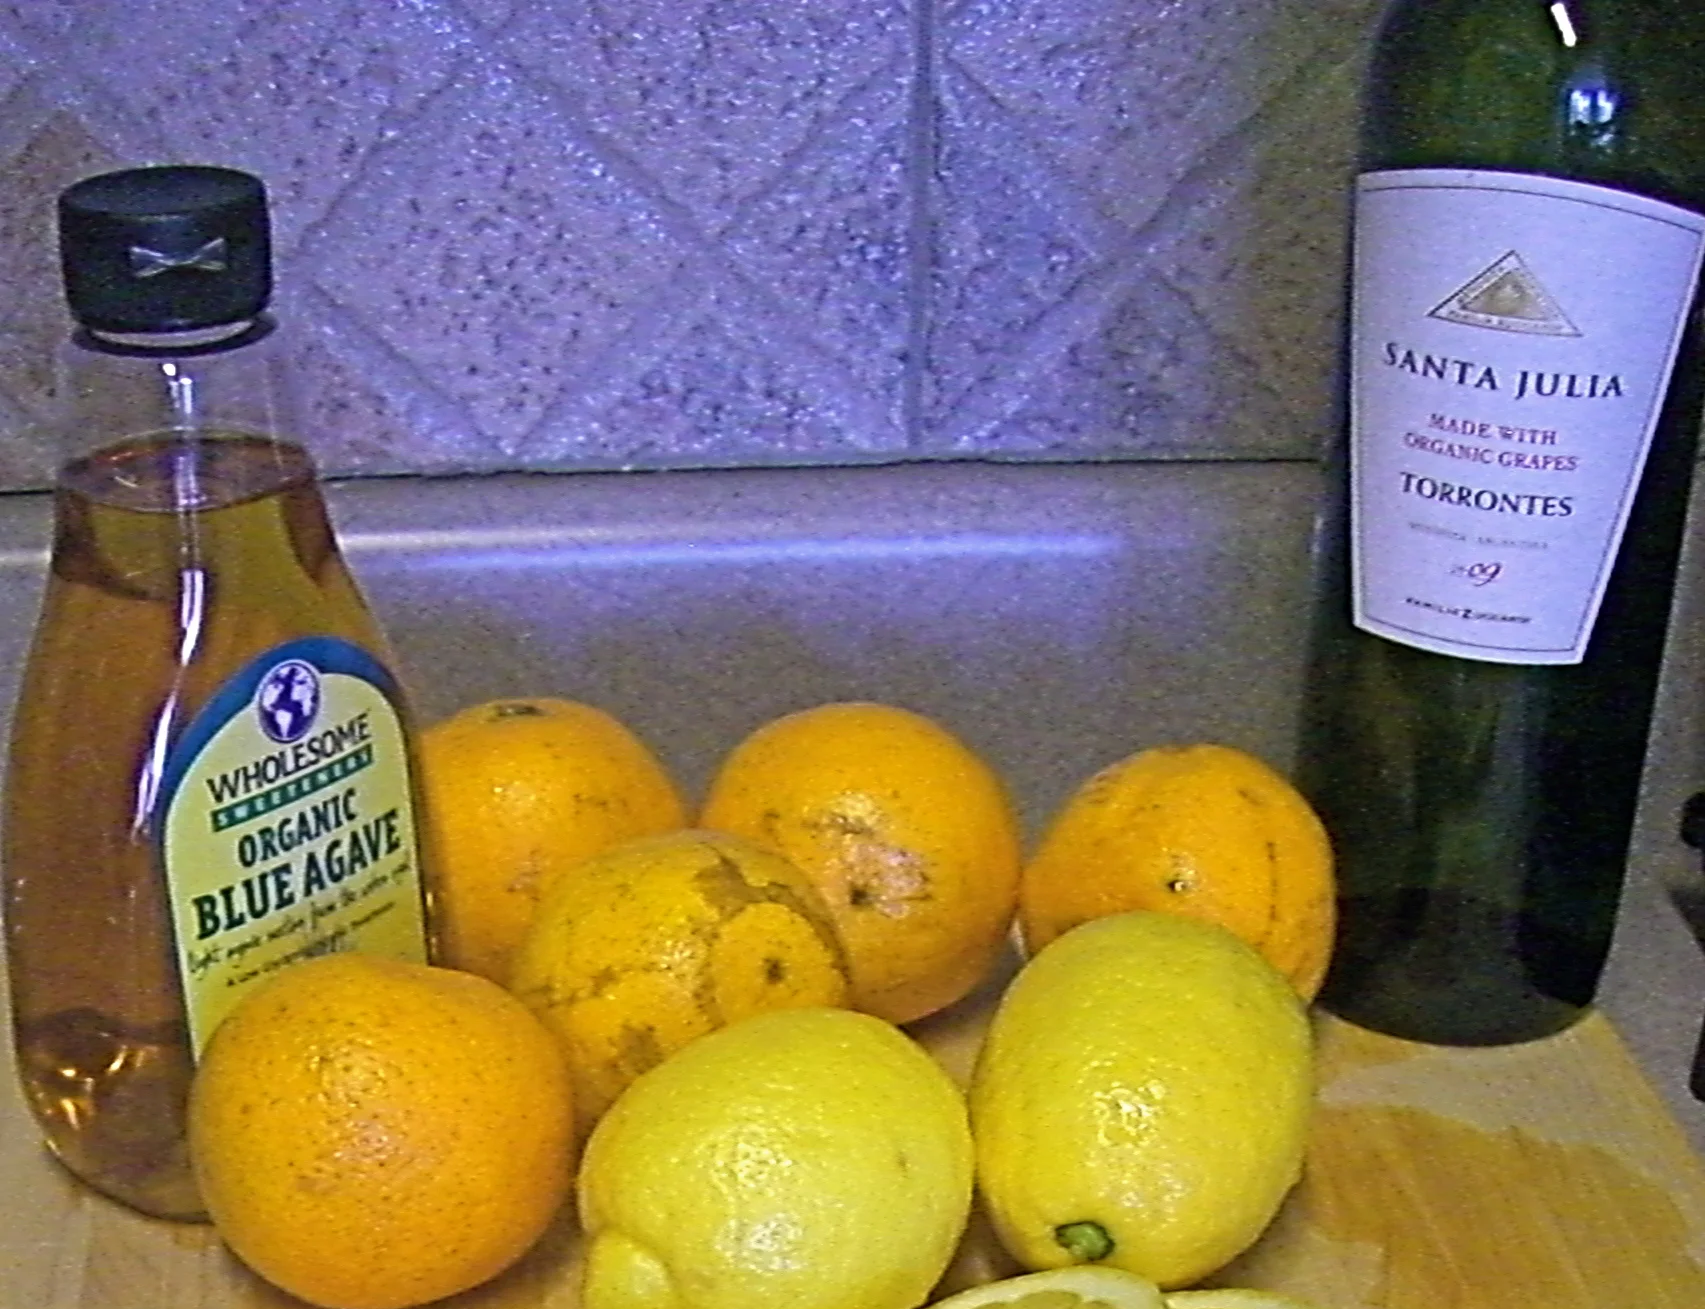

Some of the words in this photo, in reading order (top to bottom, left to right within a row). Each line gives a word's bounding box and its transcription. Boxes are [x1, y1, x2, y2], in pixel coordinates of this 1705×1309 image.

[1384, 342, 1499, 391] SANTA
[1514, 369, 1624, 400] JULIA
[1403, 432, 1492, 465] ORGANIC
[1498, 451, 1580, 472] GRAPES
[1428, 412, 1489, 440] MADE
[1497, 424, 1558, 446] WITH
[1400, 471, 1574, 517] TORRONTES
[206, 712, 373, 804] WHOLESOME
[217, 750, 370, 828] SWEETENERS
[237, 787, 358, 868] ORGANIC
[192, 862, 296, 941] BLUE
[303, 808, 402, 898] AGAVE
